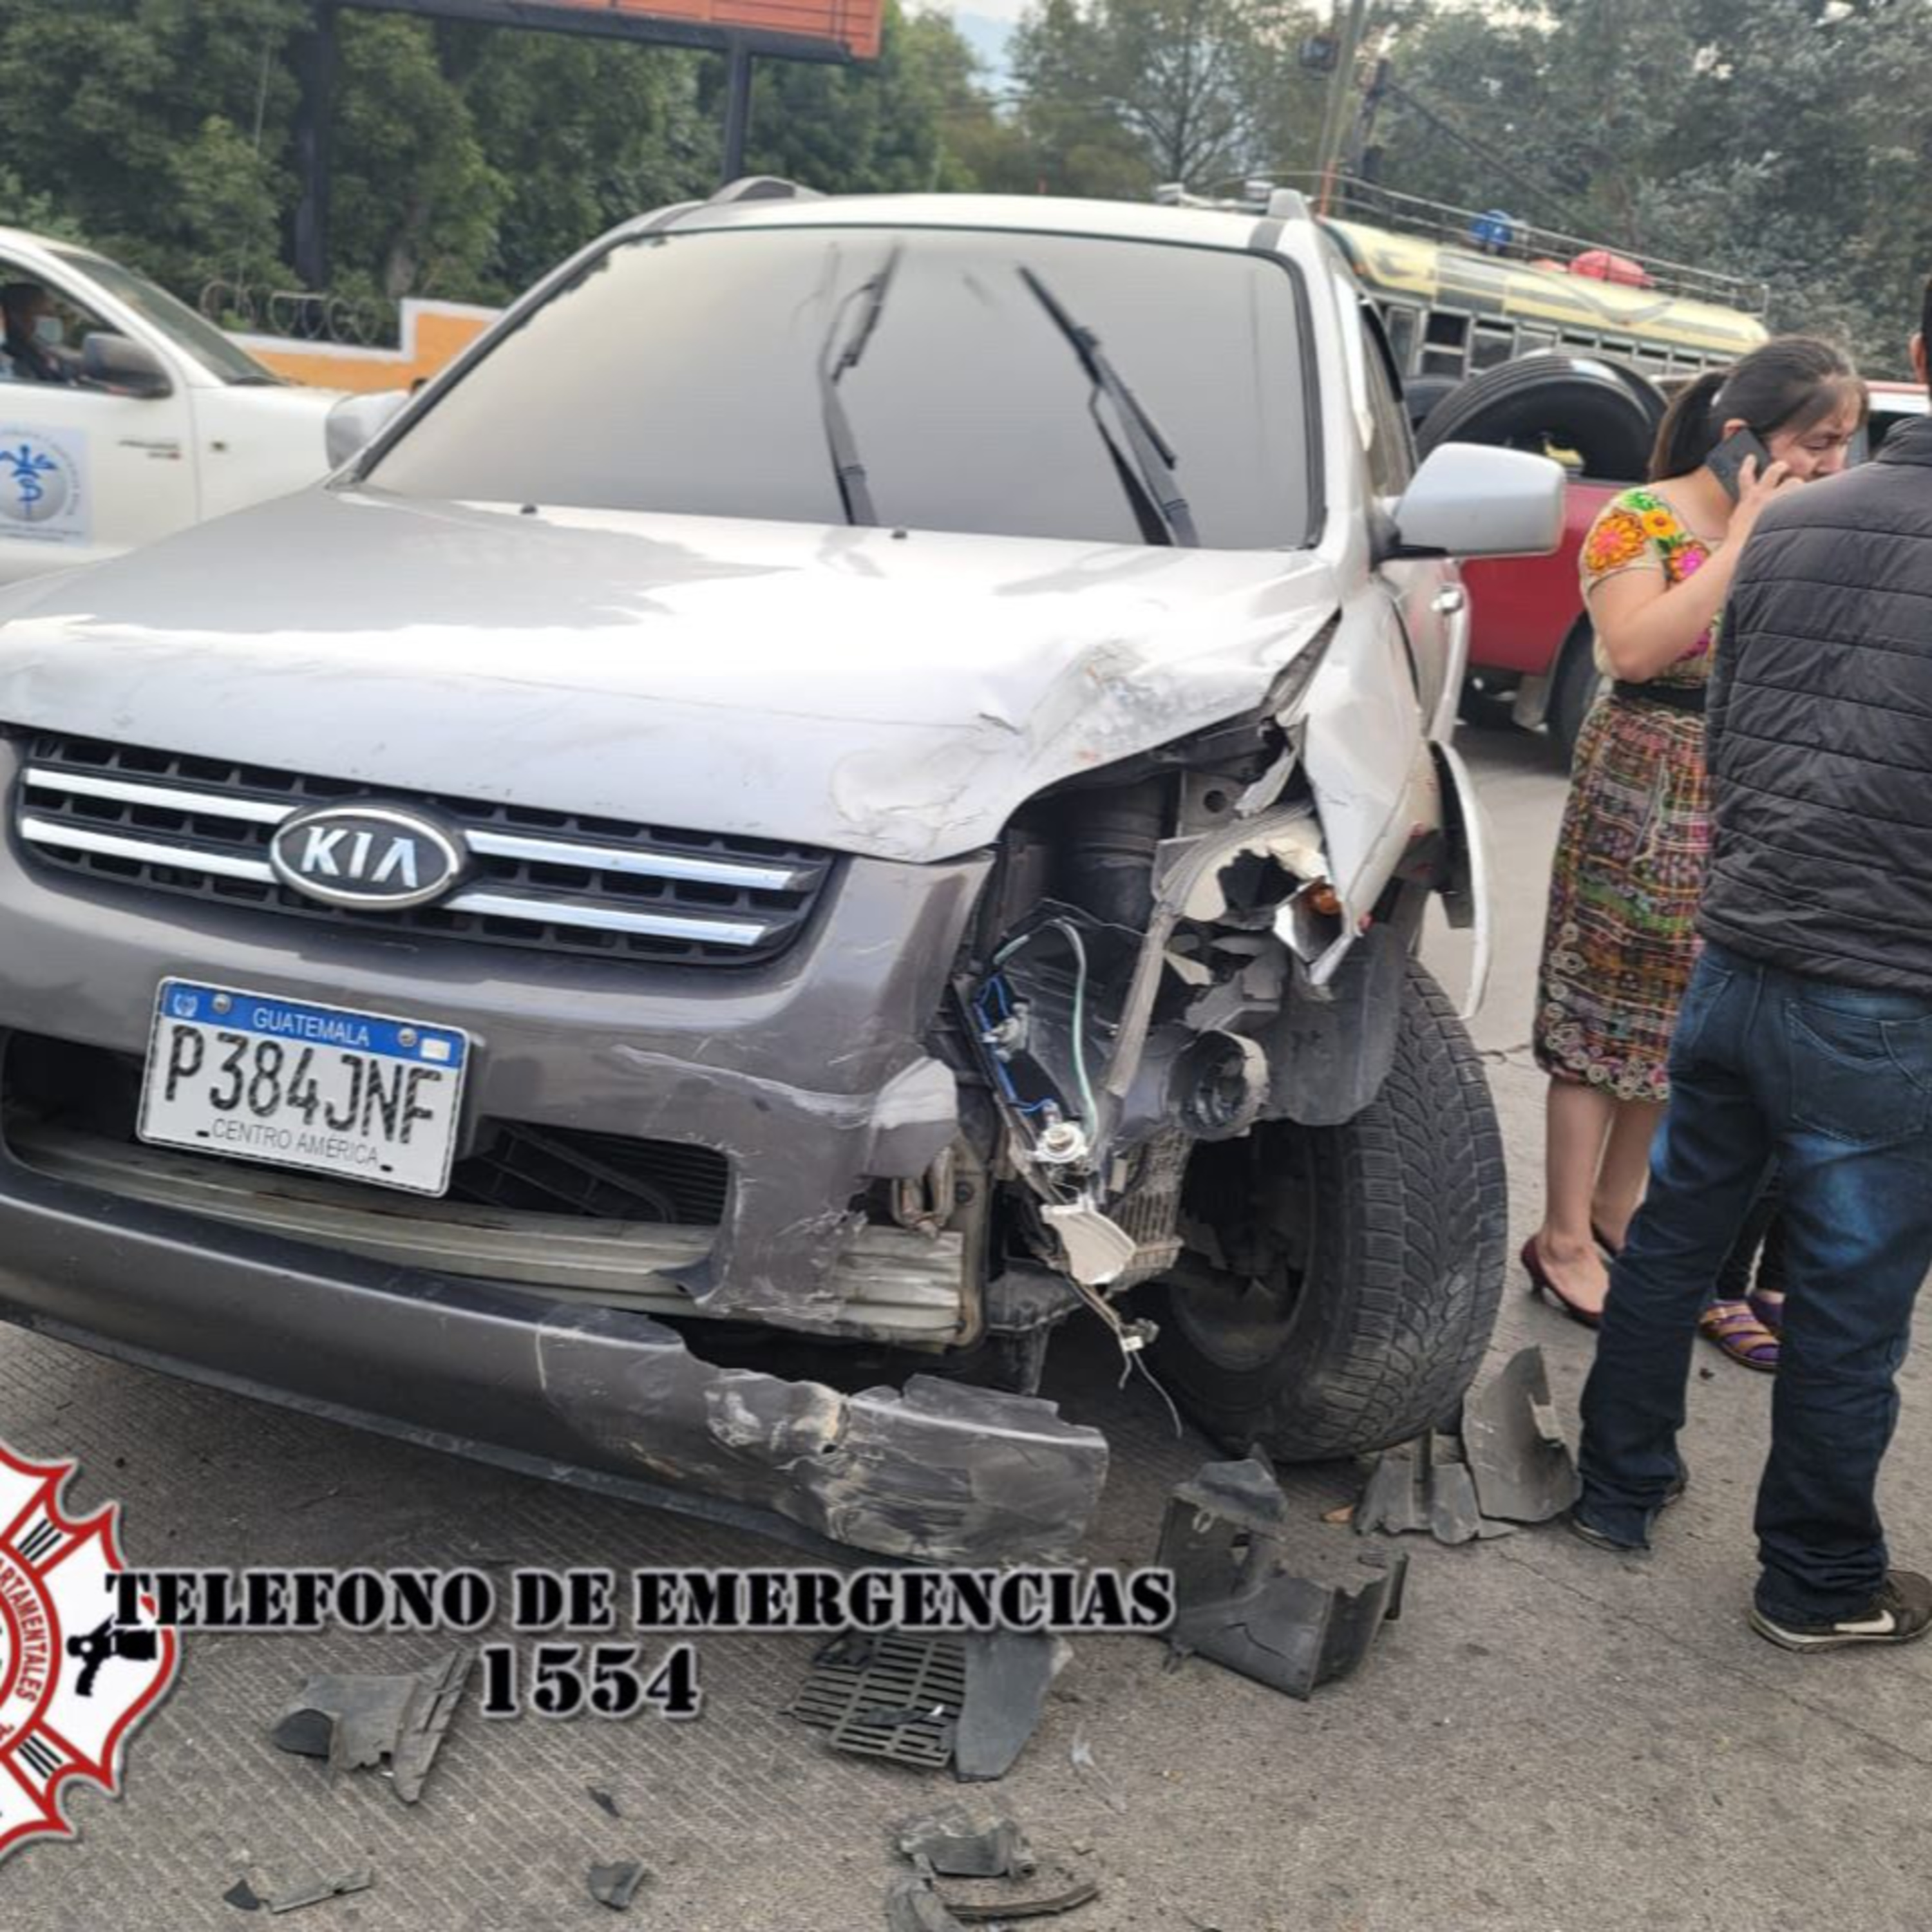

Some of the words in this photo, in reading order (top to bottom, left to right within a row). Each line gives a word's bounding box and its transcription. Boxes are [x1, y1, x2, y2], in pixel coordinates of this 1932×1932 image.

[301, 826, 419, 888] KIA
[253, 1007, 370, 1048] GUATEMALA
[165, 1025, 442, 1144] P384JNF
[212, 1118, 292, 1150] CENTRO
